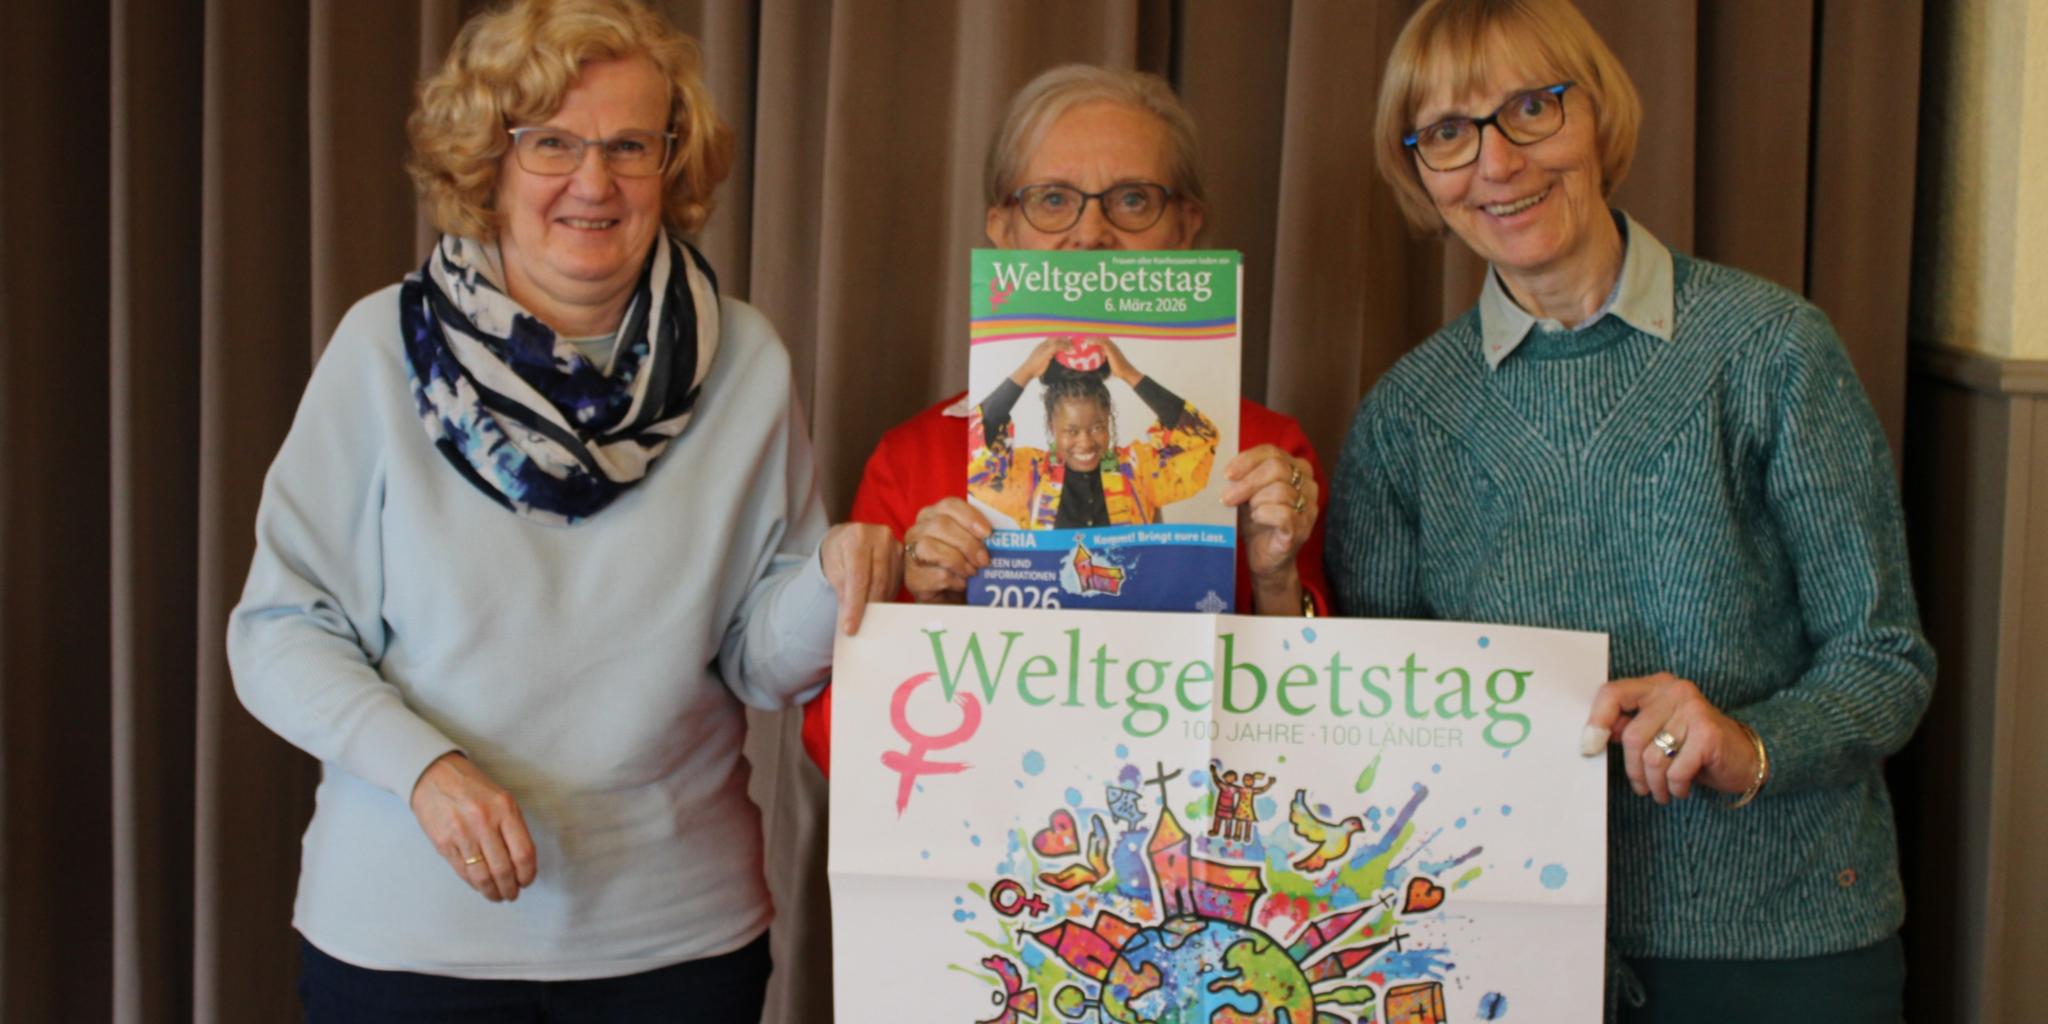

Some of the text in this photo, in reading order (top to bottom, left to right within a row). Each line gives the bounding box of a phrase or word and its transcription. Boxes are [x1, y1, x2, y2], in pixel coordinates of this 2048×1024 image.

[992, 260, 1213, 302] Weltgebetstag
[1104, 298, 1187, 312] 6. März 2026
[1093, 533, 1136, 546] Kommt!
[1138, 531, 1173, 545] Bringt
[1174, 534, 1200, 543] eure
[992, 557, 1032, 569] EEN UND
[984, 569, 1057, 582] INFORMATIONEN
[984, 585, 1061, 610] 2026
[922, 628, 1534, 749] Weltgebetstag
[1181, 720, 1220, 742] 100
[1226, 722, 1305, 744] JAHRE
[1319, 725, 1361, 746] 100
[1368, 722, 1465, 749] LÄNDER
